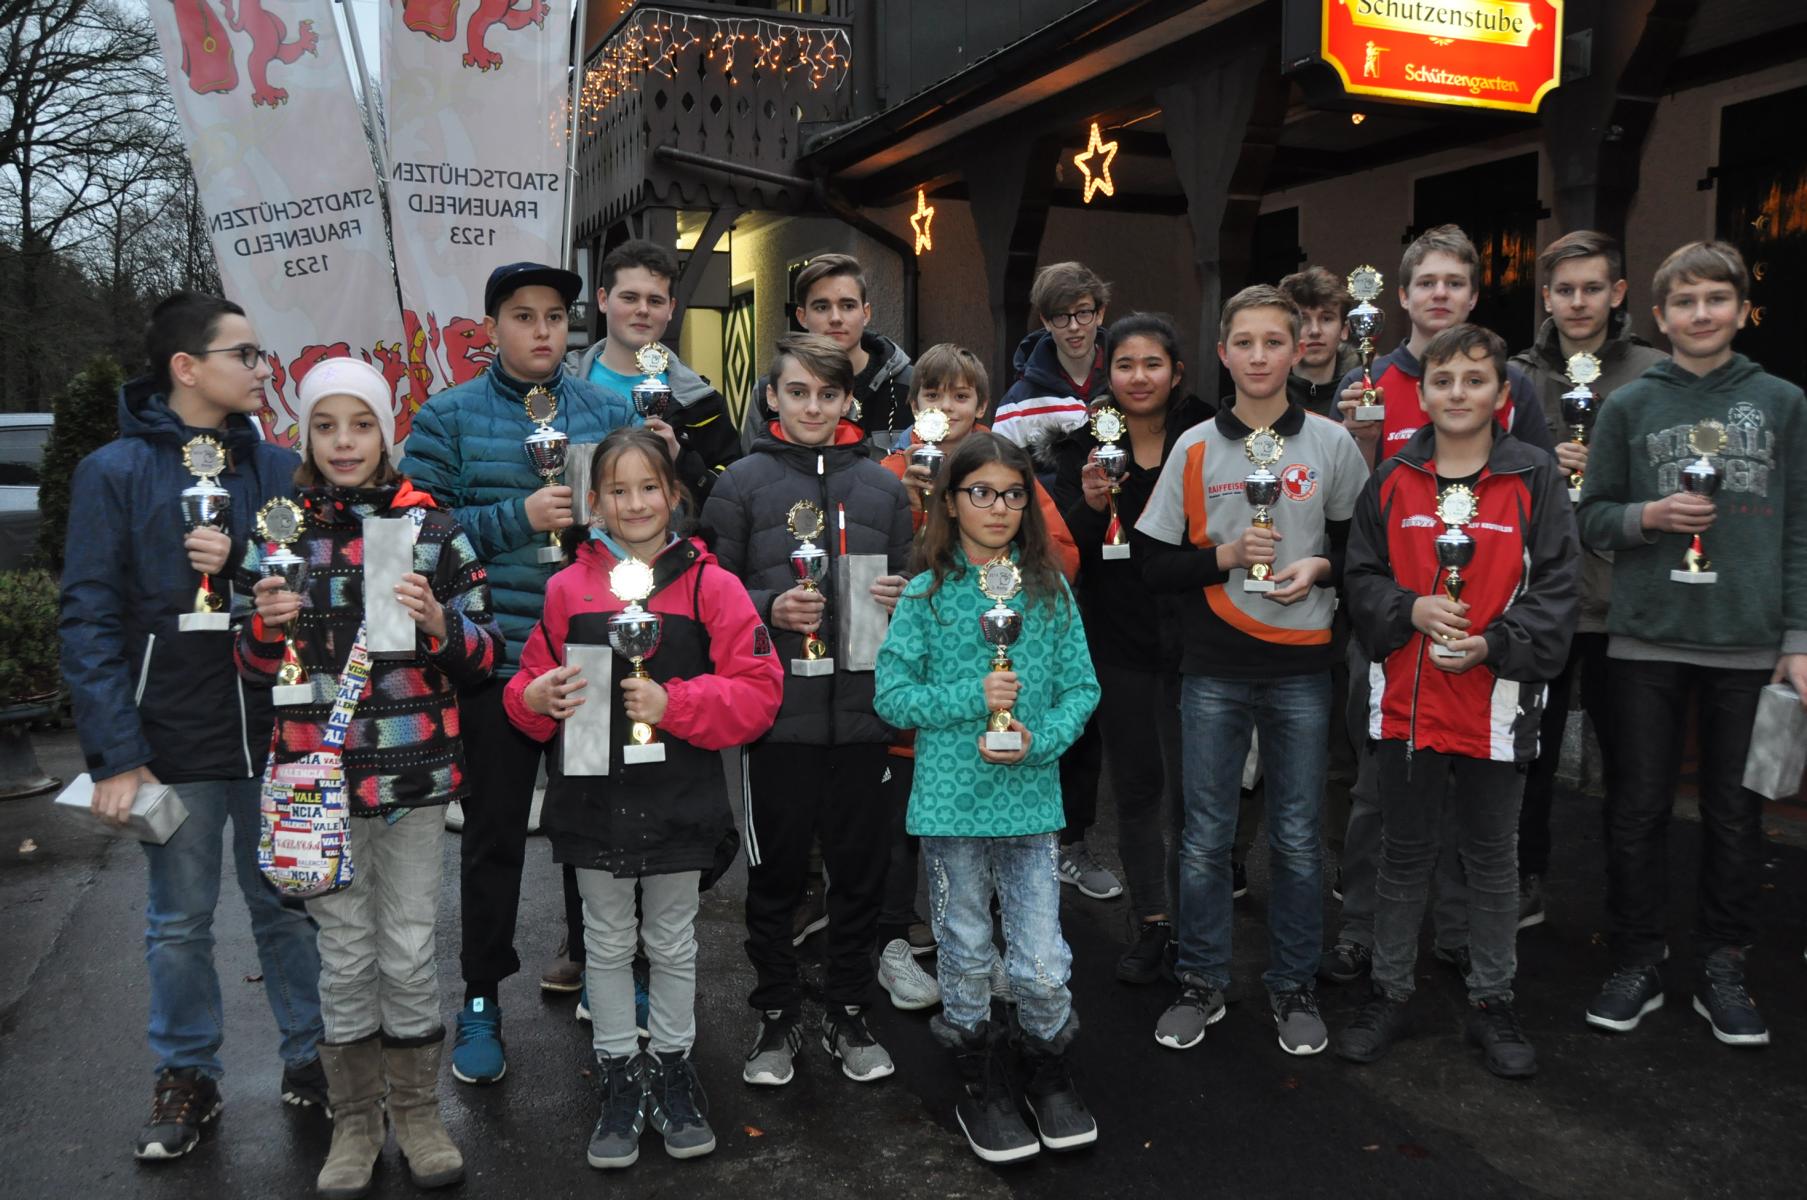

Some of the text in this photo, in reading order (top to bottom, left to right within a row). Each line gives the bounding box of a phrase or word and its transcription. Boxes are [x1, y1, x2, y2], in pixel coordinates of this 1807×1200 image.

[1405, 64, 1519, 94] Schützengarten
[294, 792, 322, 803] VALE
[292, 806, 322, 818] NCIA
[313, 822, 339, 831] VALE
[291, 871, 320, 882] NCIA
